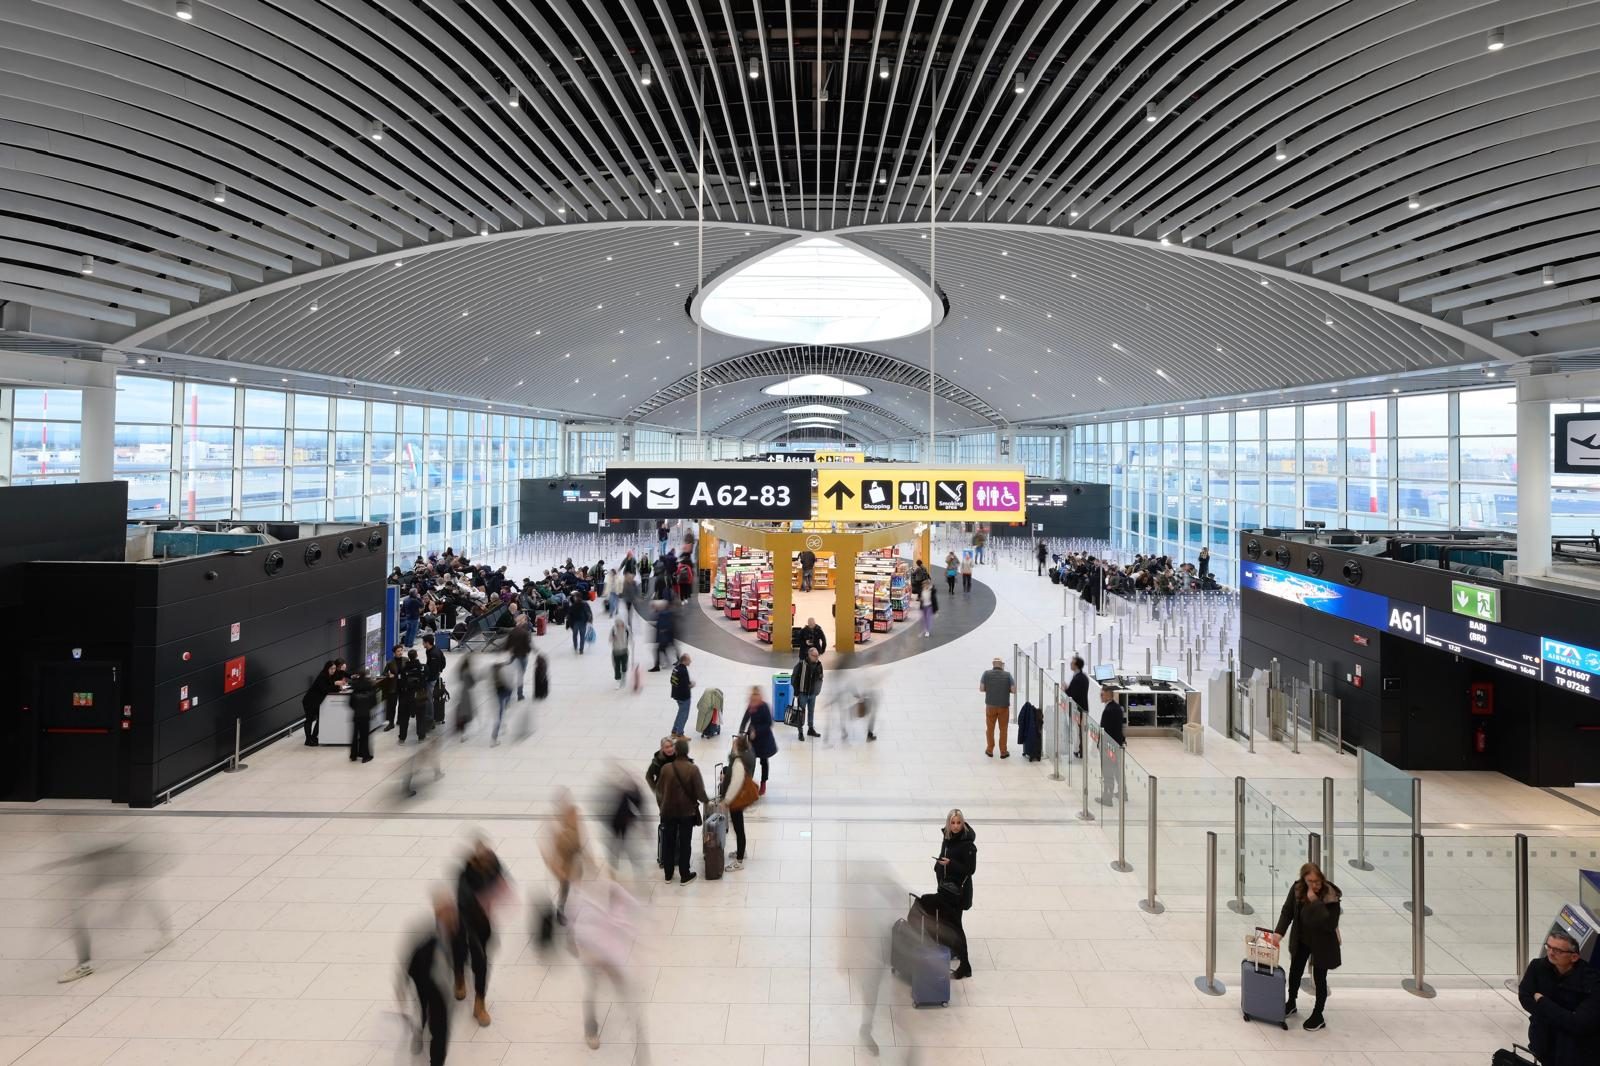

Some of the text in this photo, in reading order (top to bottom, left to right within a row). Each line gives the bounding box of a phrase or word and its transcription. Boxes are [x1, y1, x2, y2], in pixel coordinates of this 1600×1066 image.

[939, 500, 964, 508] Smoking
[1388, 608, 1421, 635] A61
[1469, 620, 1487, 632] BARI
[1469, 632, 1487, 645] (BRI)
[1545, 641, 1582, 660] ITA
[1547, 653, 1580, 666] AIRWAYS
[1555, 666, 1590, 682] AZ 01607
[1555, 676, 1590, 694] TP 07236
